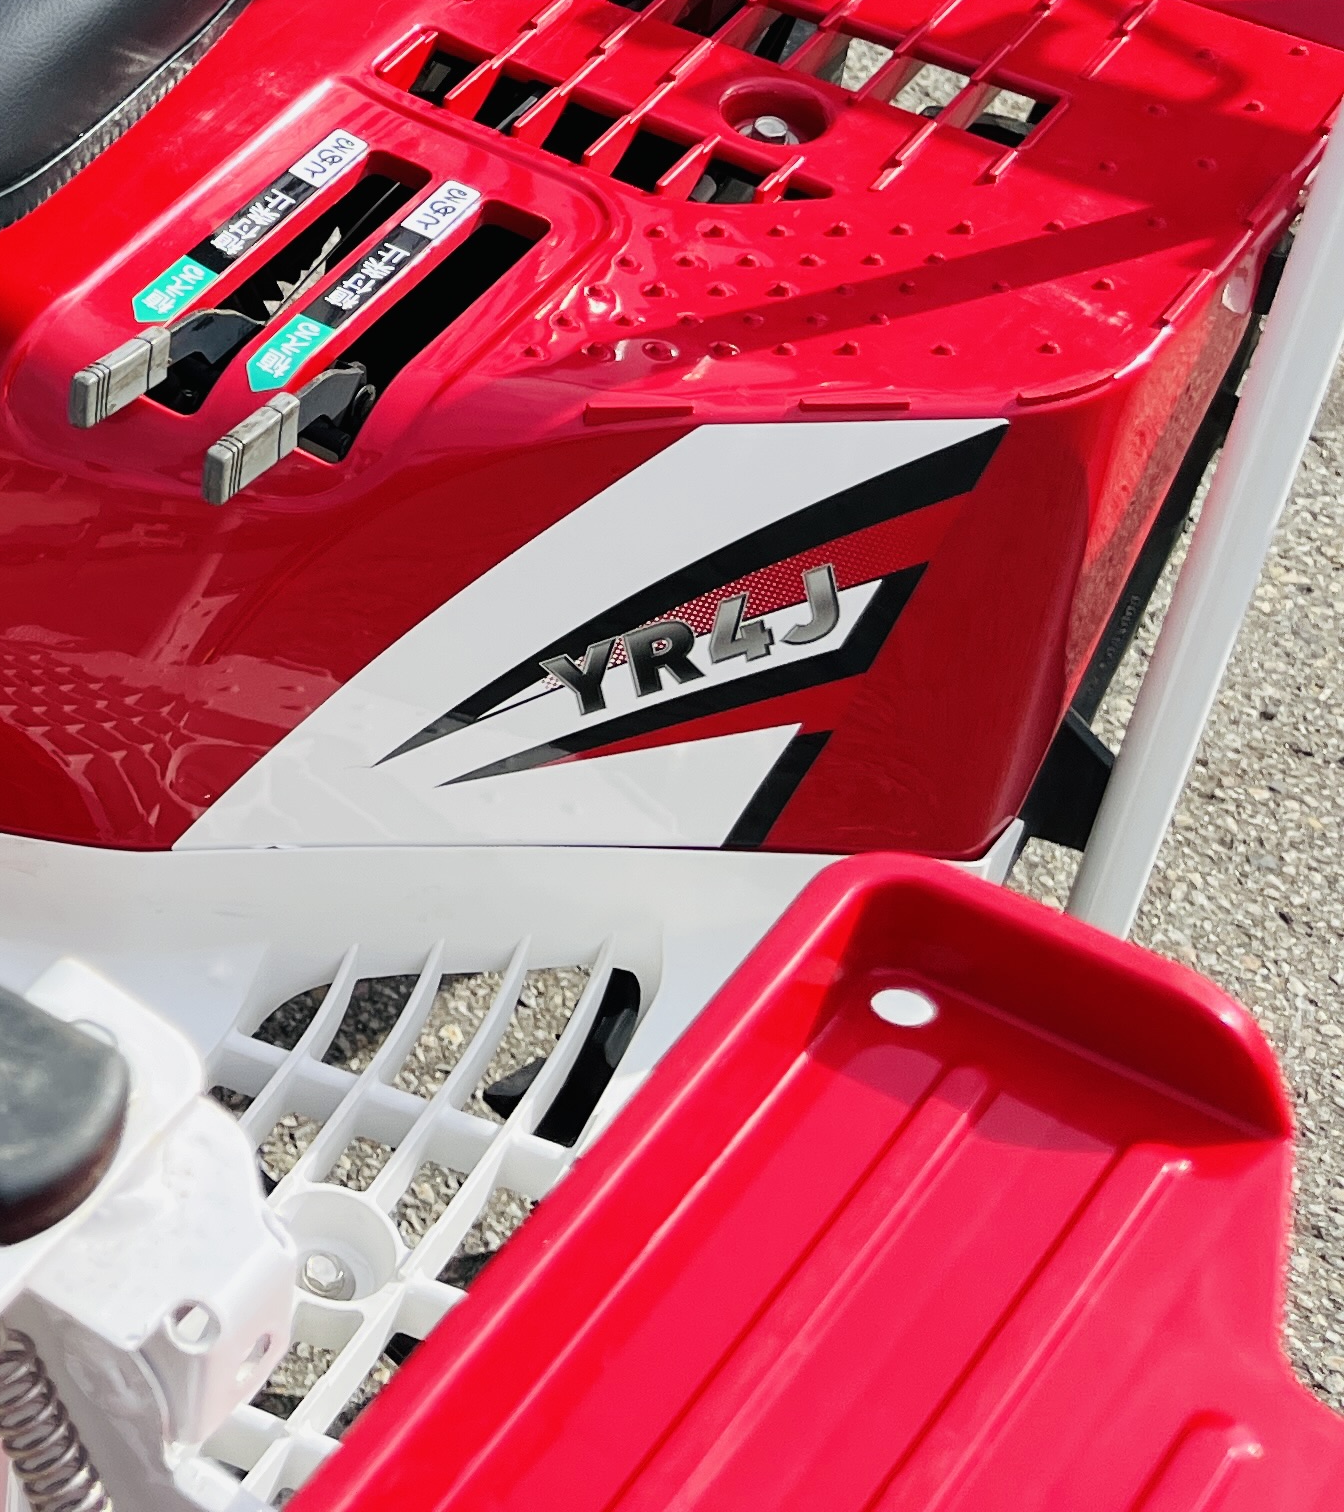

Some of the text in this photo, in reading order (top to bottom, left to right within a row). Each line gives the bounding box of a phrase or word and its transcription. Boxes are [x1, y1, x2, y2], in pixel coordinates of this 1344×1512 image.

[302, 131, 356, 179] とめる
[209, 186, 296, 257] 植付条止
[415, 182, 470, 229] とめる
[141, 259, 207, 314] 植える
[323, 240, 411, 311] 植付条止
[255, 317, 323, 378] 植える
[539, 562, 841, 716] YR4J
